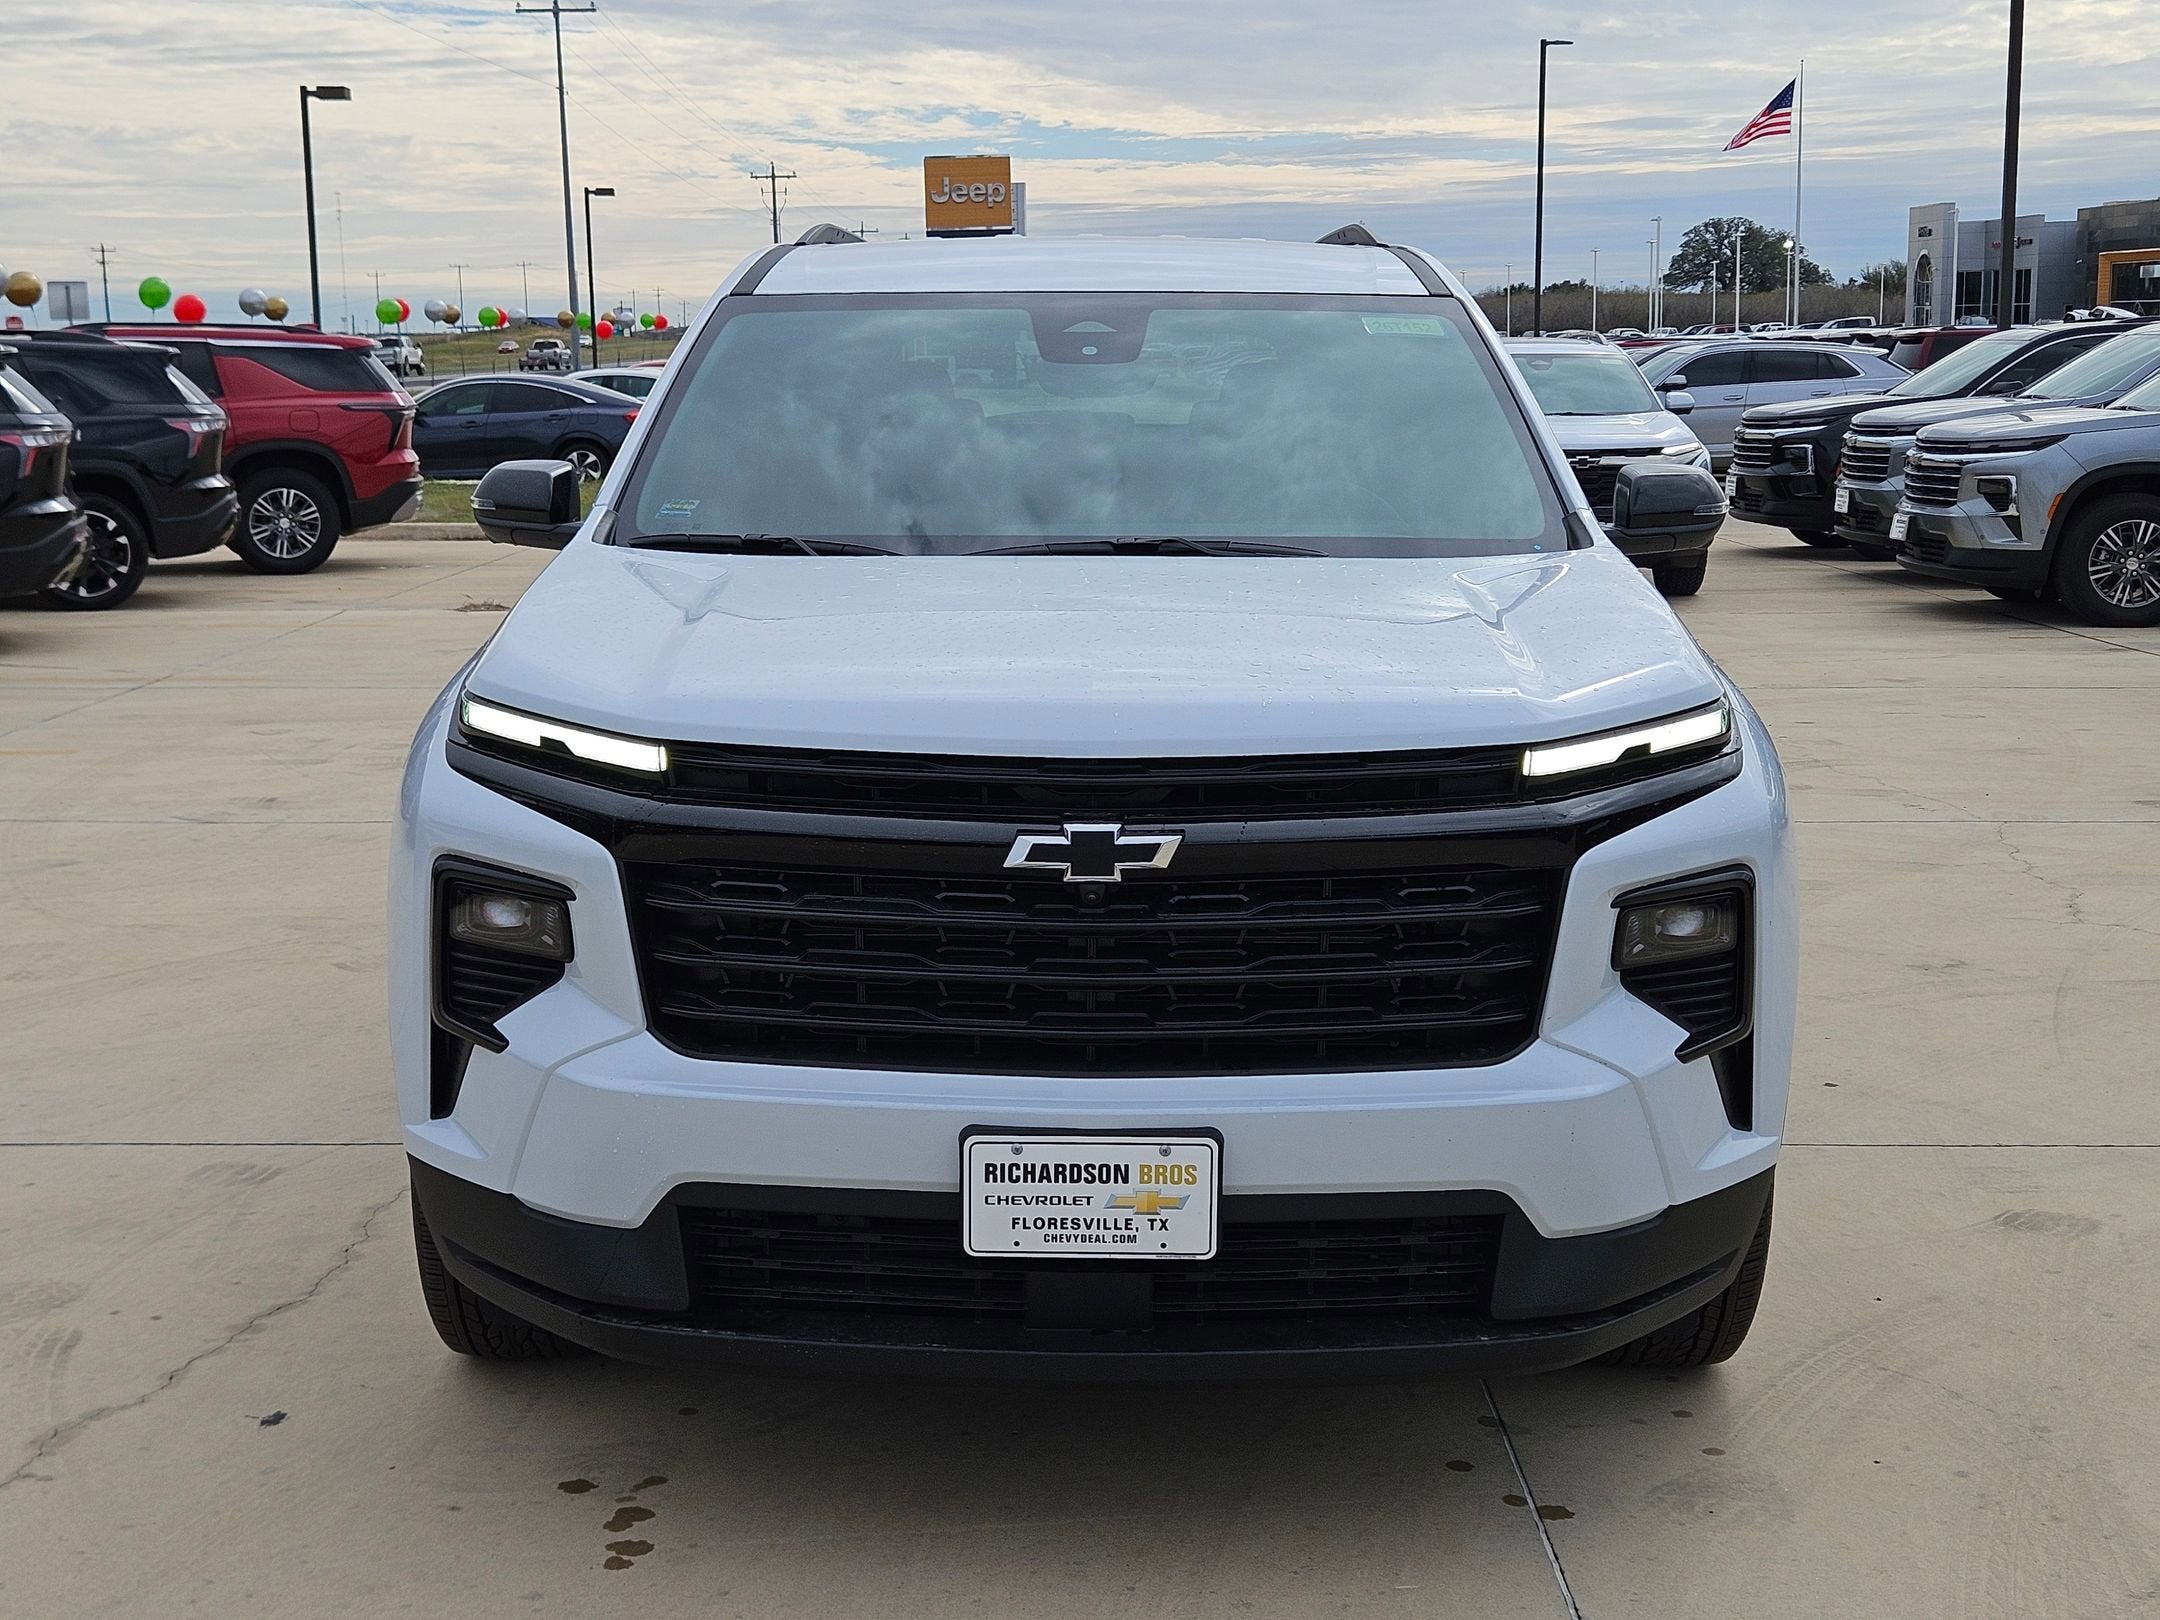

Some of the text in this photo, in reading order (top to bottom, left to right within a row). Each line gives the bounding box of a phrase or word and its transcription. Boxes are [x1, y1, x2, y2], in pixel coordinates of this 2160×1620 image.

[930, 176, 1006, 208] Jeep
[984, 1162, 1198, 1185] RICHARDSON BROS
[984, 1195, 1094, 1206] CHEVROLET
[1011, 1217, 1169, 1233] FLORESVILLE, TX
[1043, 1233, 1137, 1244] CHEVYDEAL.COM
